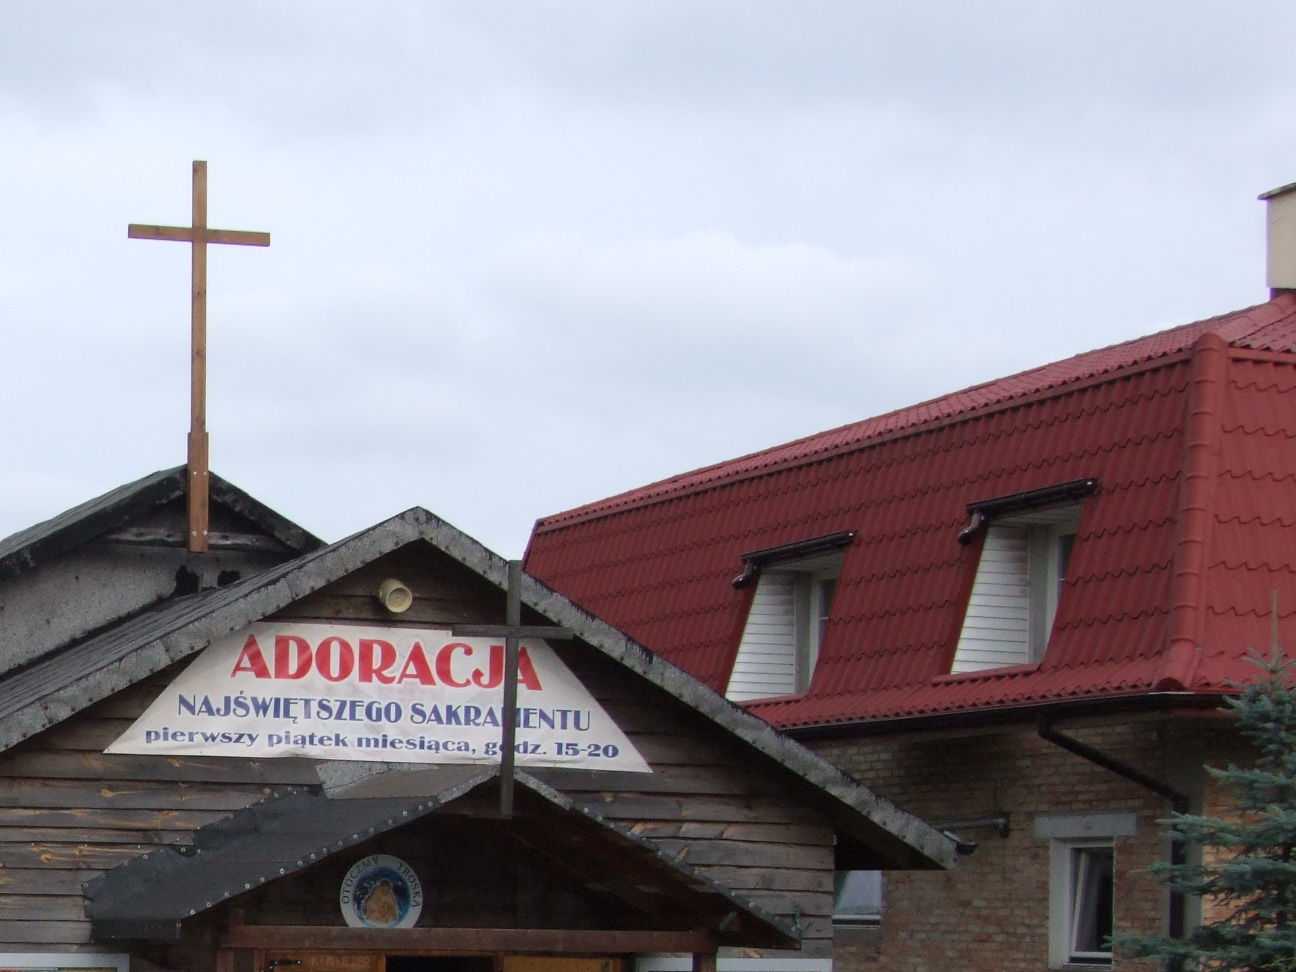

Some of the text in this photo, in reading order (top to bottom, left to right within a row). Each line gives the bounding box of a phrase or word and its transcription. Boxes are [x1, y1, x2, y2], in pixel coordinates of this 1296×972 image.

[230, 634, 542, 691] ADORACJA
[177, 691, 402, 725] NAJŚWIĘTSZEGO
[145, 727, 619, 758] pierwszy piątek miesiąca, gdz. 15-20
[342, 856, 381, 904] OTOCZMY
